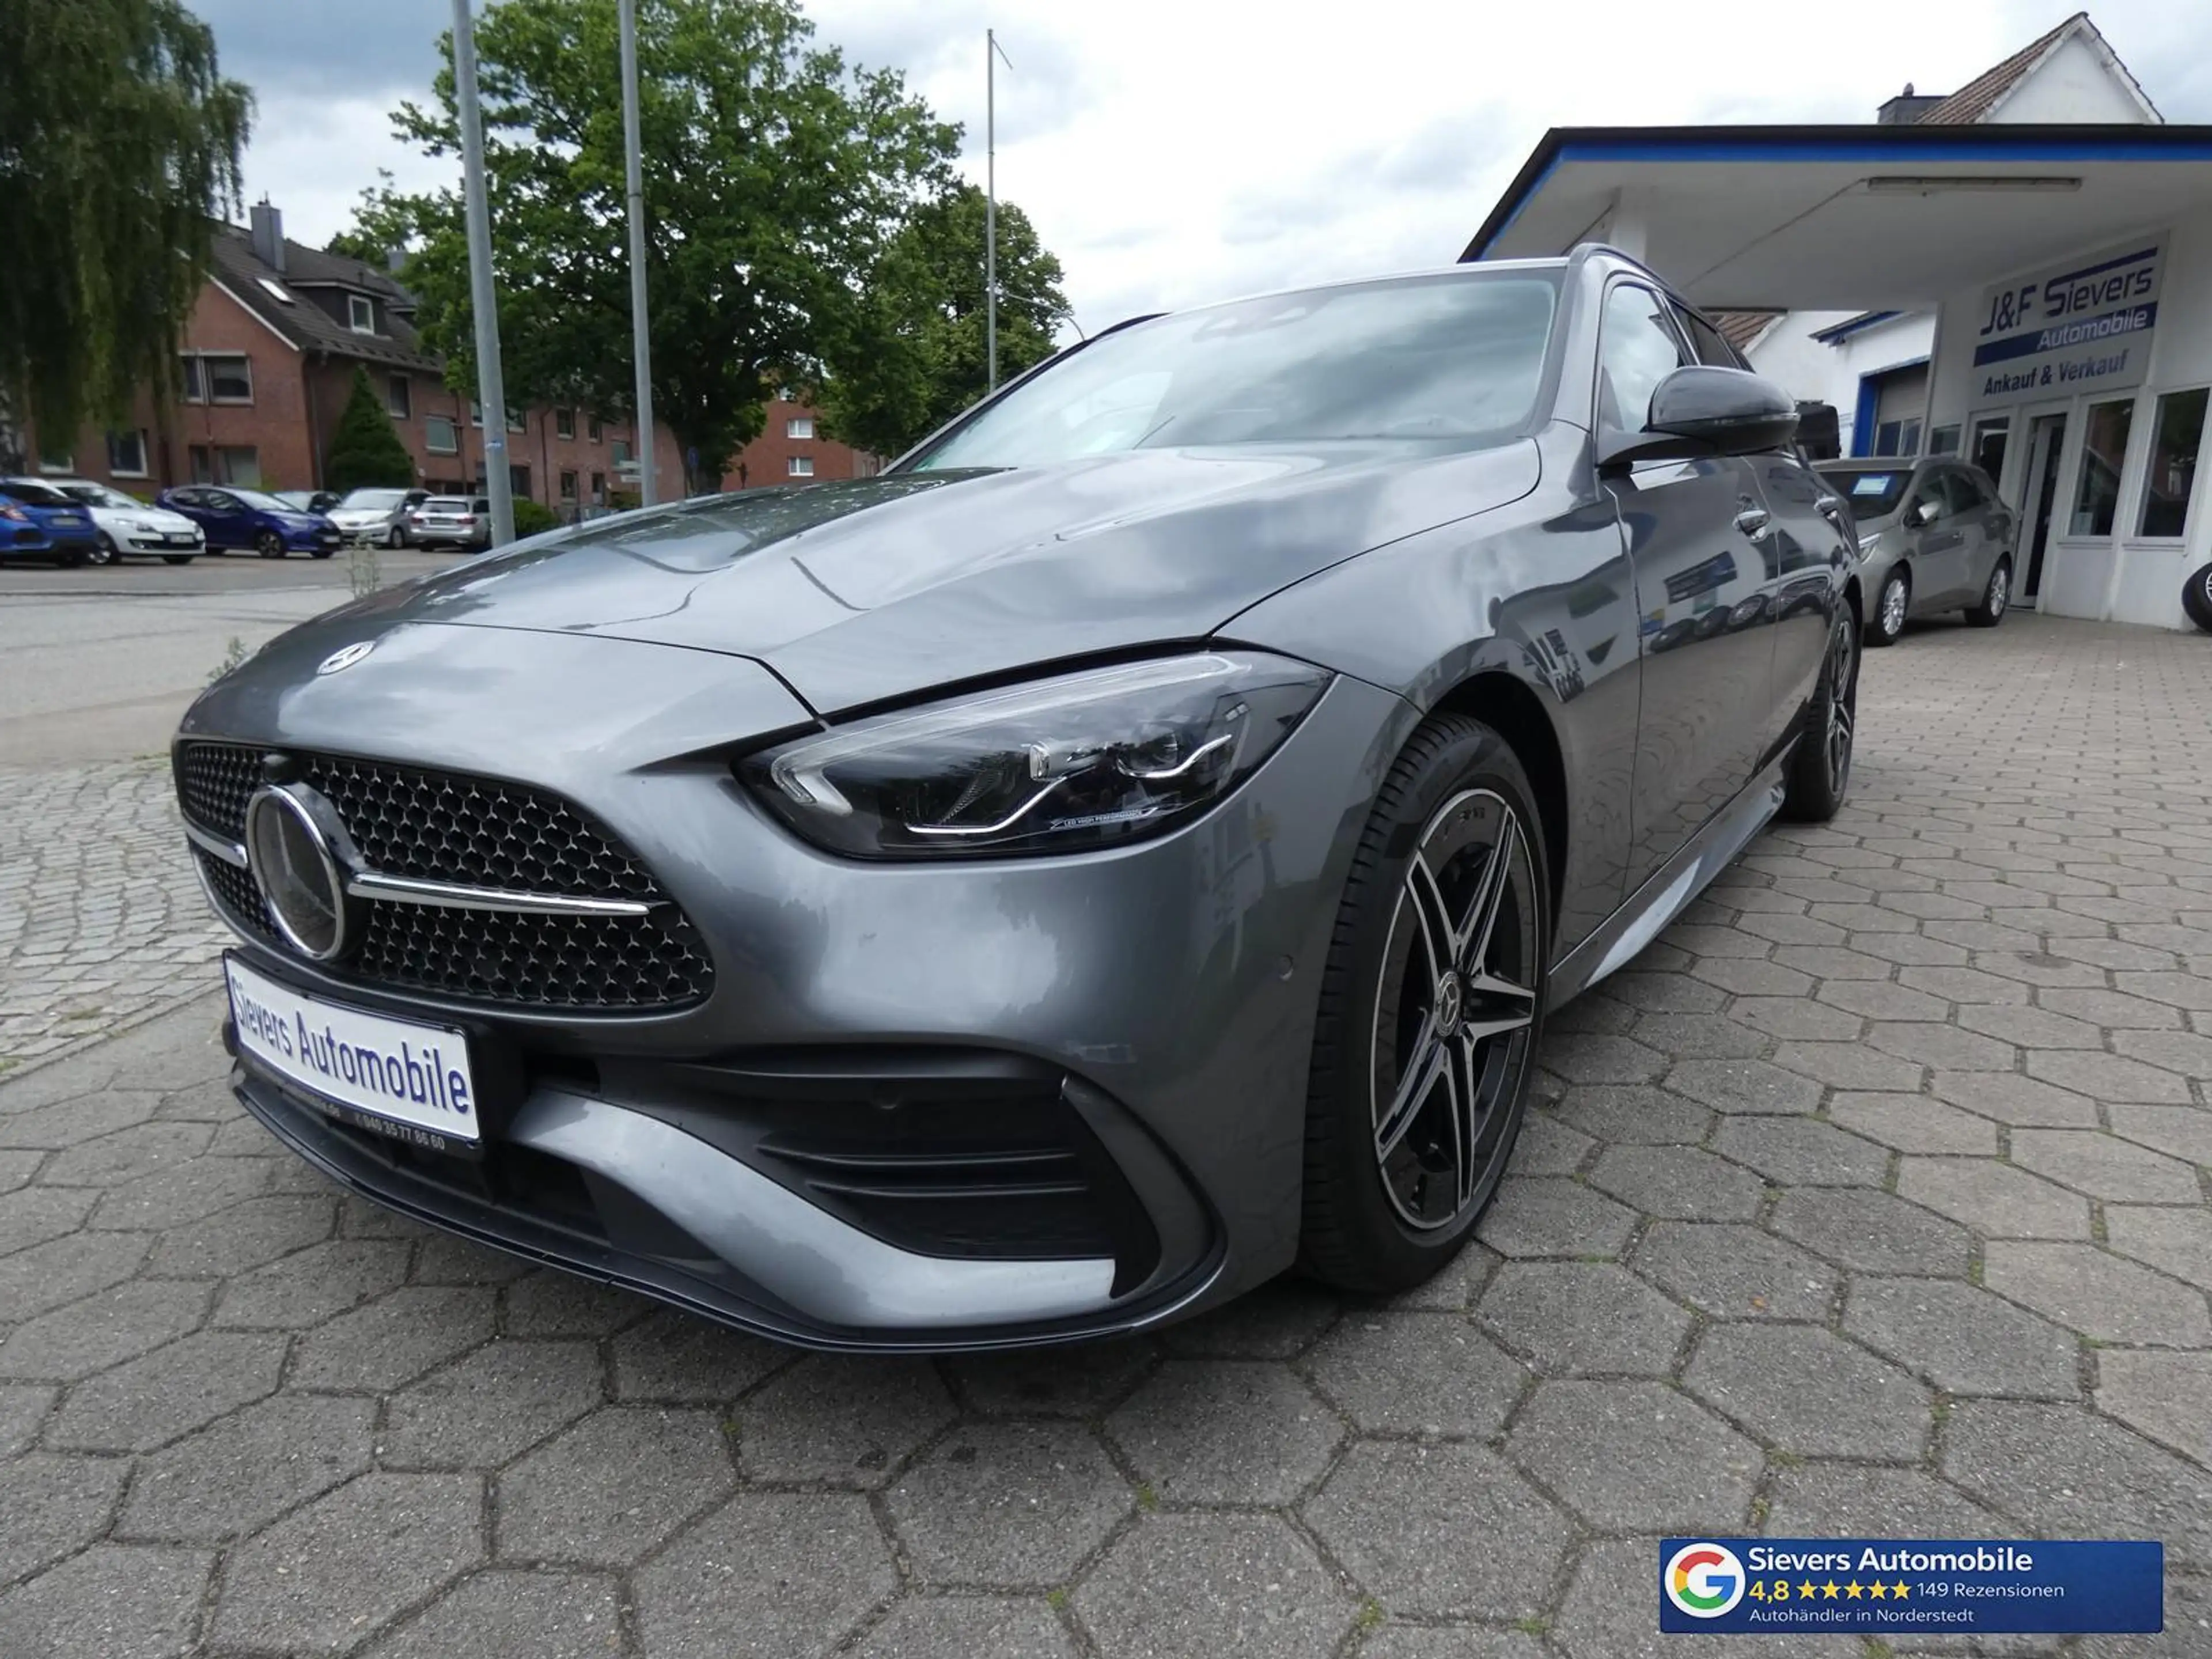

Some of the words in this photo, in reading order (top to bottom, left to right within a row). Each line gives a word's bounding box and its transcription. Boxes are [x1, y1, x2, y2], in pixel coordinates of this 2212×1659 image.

[1980, 285, 2036, 336] J&F
[2044, 267, 2154, 317] Sievers
[2037, 308, 2148, 350] Automobile
[1983, 366, 2037, 396] Ankauf
[2041, 366, 2052, 384] &
[2059, 348, 2129, 382] Verkauf
[231, 975, 292, 1056] Sievers
[296, 1011, 470, 1114] Automobile
